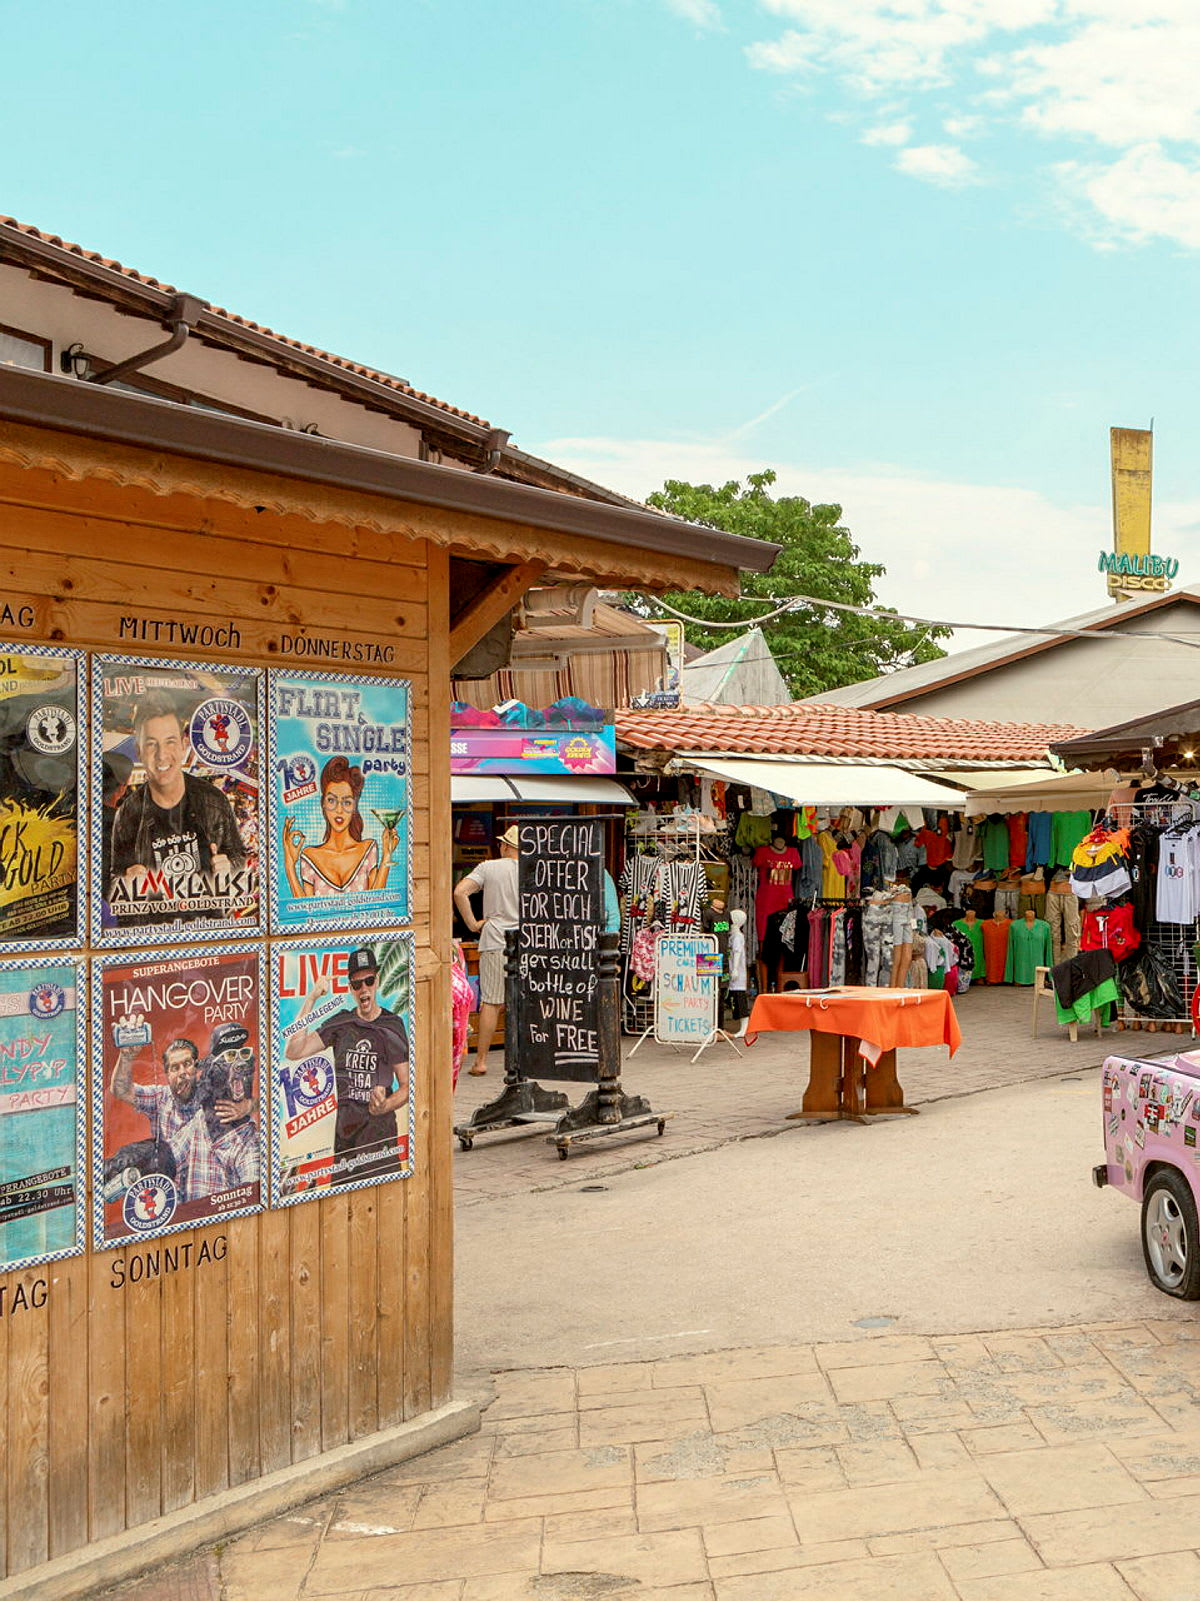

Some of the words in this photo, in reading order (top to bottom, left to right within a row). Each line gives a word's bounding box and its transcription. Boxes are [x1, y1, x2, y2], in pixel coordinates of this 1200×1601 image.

[1098, 551, 1180, 580] MALIBU
[1107, 575, 1172, 590] DISCO
[281, 635, 395, 662] DONNERSTAG
[103, 676, 145, 697] LIVE
[278, 687, 361, 720] FLIRT
[316, 723, 407, 754] SINGLE
[197, 743, 247, 763] GOLDSTRAND
[363, 758, 407, 776] party
[286, 785, 316, 801] JAHRE
[31, 871, 77, 894] PARTY
[535, 860, 589, 892] OFFER
[112, 902, 150, 916] PRINZ
[151, 900, 178, 912] VOM
[179, 896, 255, 911] GOLDSTRAND
[521, 892, 549, 919] FOR
[553, 892, 591, 920] EACH
[520, 923, 560, 950] STEAK
[560, 938, 573, 949] or
[660, 940, 710, 957] PREMIUM
[132, 957, 220, 978] SUPERANGEBOTE
[280, 953, 348, 997] LIVE
[528, 971, 573, 995] bottle
[576, 973, 598, 1002] of
[663, 973, 711, 995] SCHAUM
[110, 975, 254, 1017] HANGOVER
[204, 1002, 249, 1024] PARTY
[540, 997, 584, 1021] WINE
[556, 1023, 599, 1052] FREE
[667, 1016, 710, 1036] TICKETS
[345, 1052, 378, 1071] KREIS
[10, 1088, 68, 1109] PARTY
[290, 1101, 335, 1135] JAHRE
[210, 1185, 253, 1206] Sonntag
[111, 1236, 228, 1289] SONNTAG
